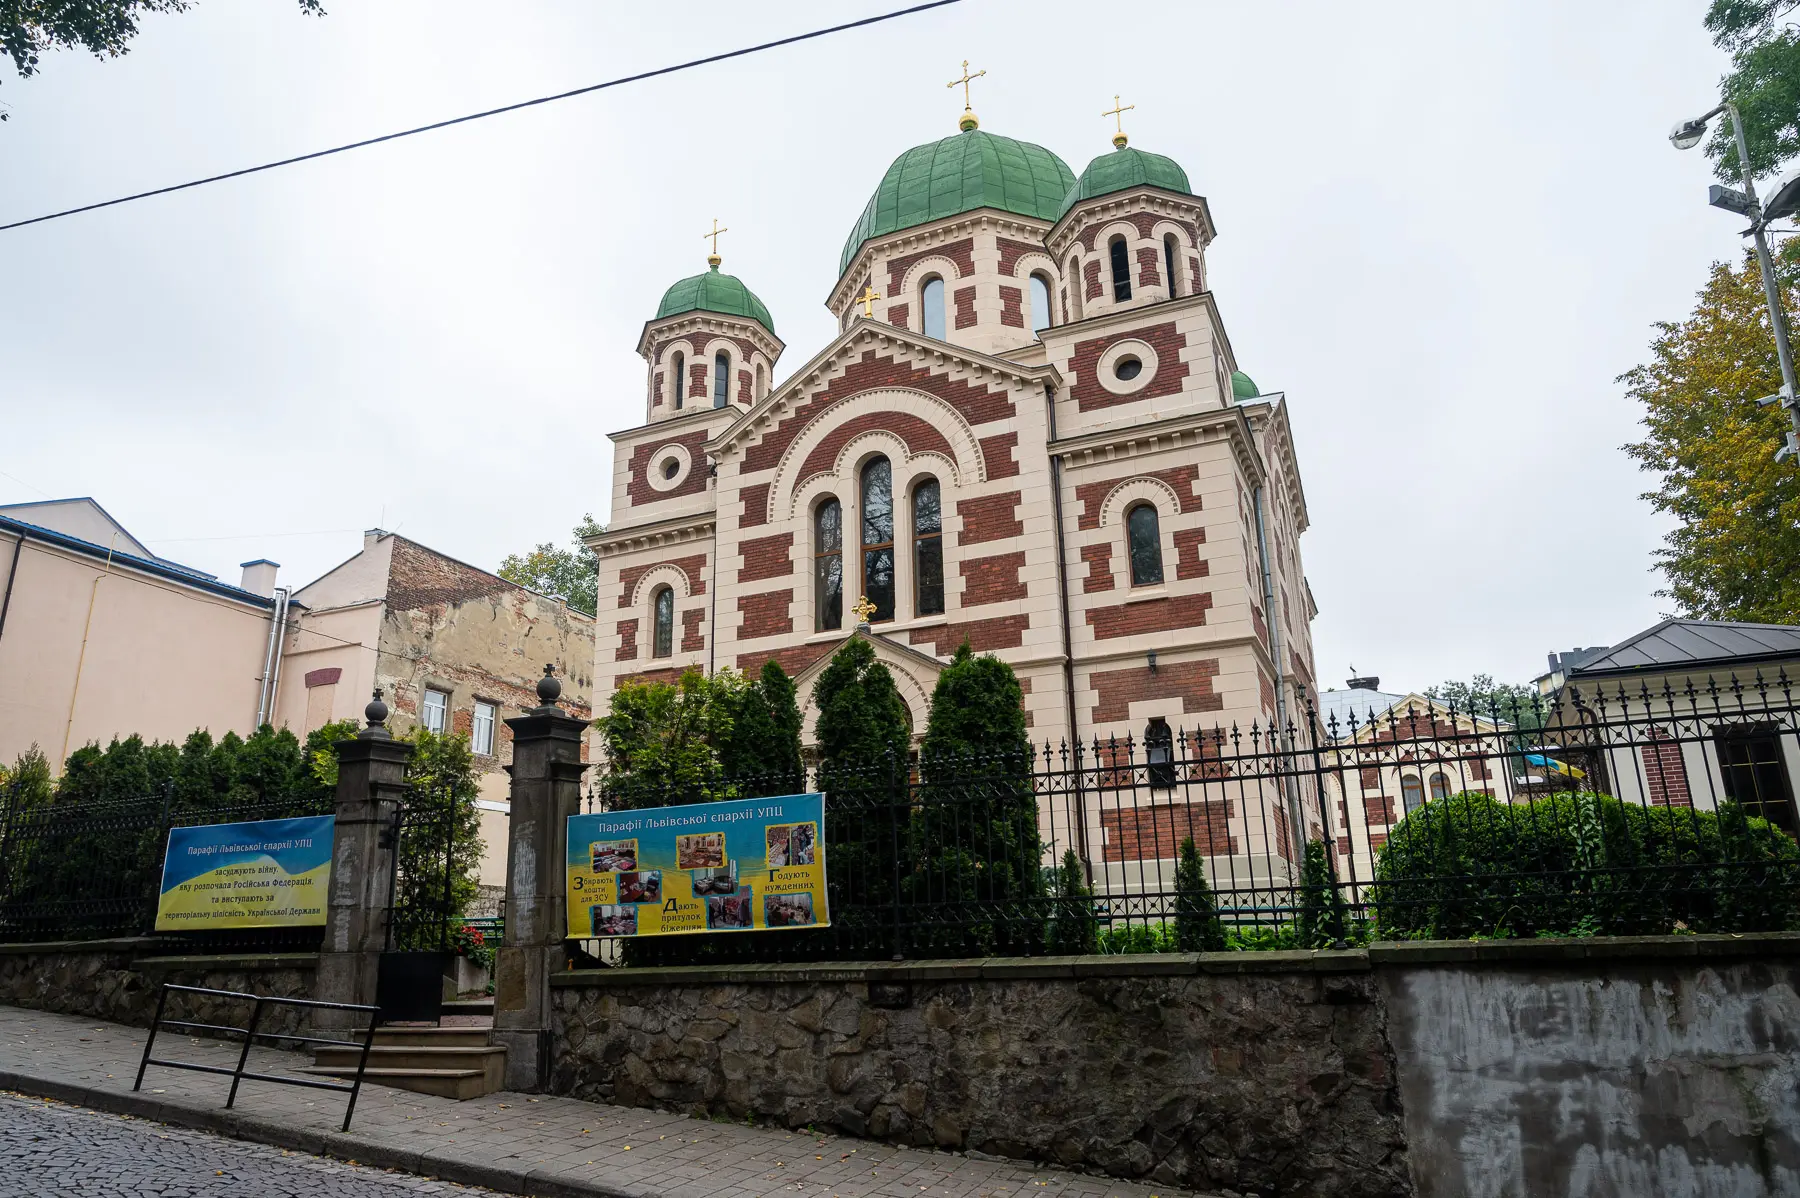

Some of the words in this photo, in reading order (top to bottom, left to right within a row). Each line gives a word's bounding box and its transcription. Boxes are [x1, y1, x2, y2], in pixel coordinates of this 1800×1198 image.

[599, 820, 642, 834] Парафії
[645, 814, 706, 829] Львівської
[711, 808, 753, 822] єпархії
[758, 806, 783, 818] УПЦ
[188, 845, 217, 856] Парафії
[220, 842, 261, 854] Львівської
[264, 840, 292, 852] єпархії
[294, 838, 312, 848] УПЦ
[215, 867, 256, 877] засуджують
[769, 868, 810, 882] Годують
[179, 883, 192, 892] яку
[194, 881, 231, 891] розпочала
[234, 879, 270, 889] Російська
[573, 876, 614, 890] Збирають
[764, 882, 814, 892] нужденних
[222, 895, 264, 905] виступають
[663, 898, 699, 914] Дають
[165, 911, 210, 920] територіальну
[212, 910, 246, 919] цілісність
[247, 908, 288, 918] Української
[289, 907, 320, 917] Держави
[662, 914, 701, 923] притулок
